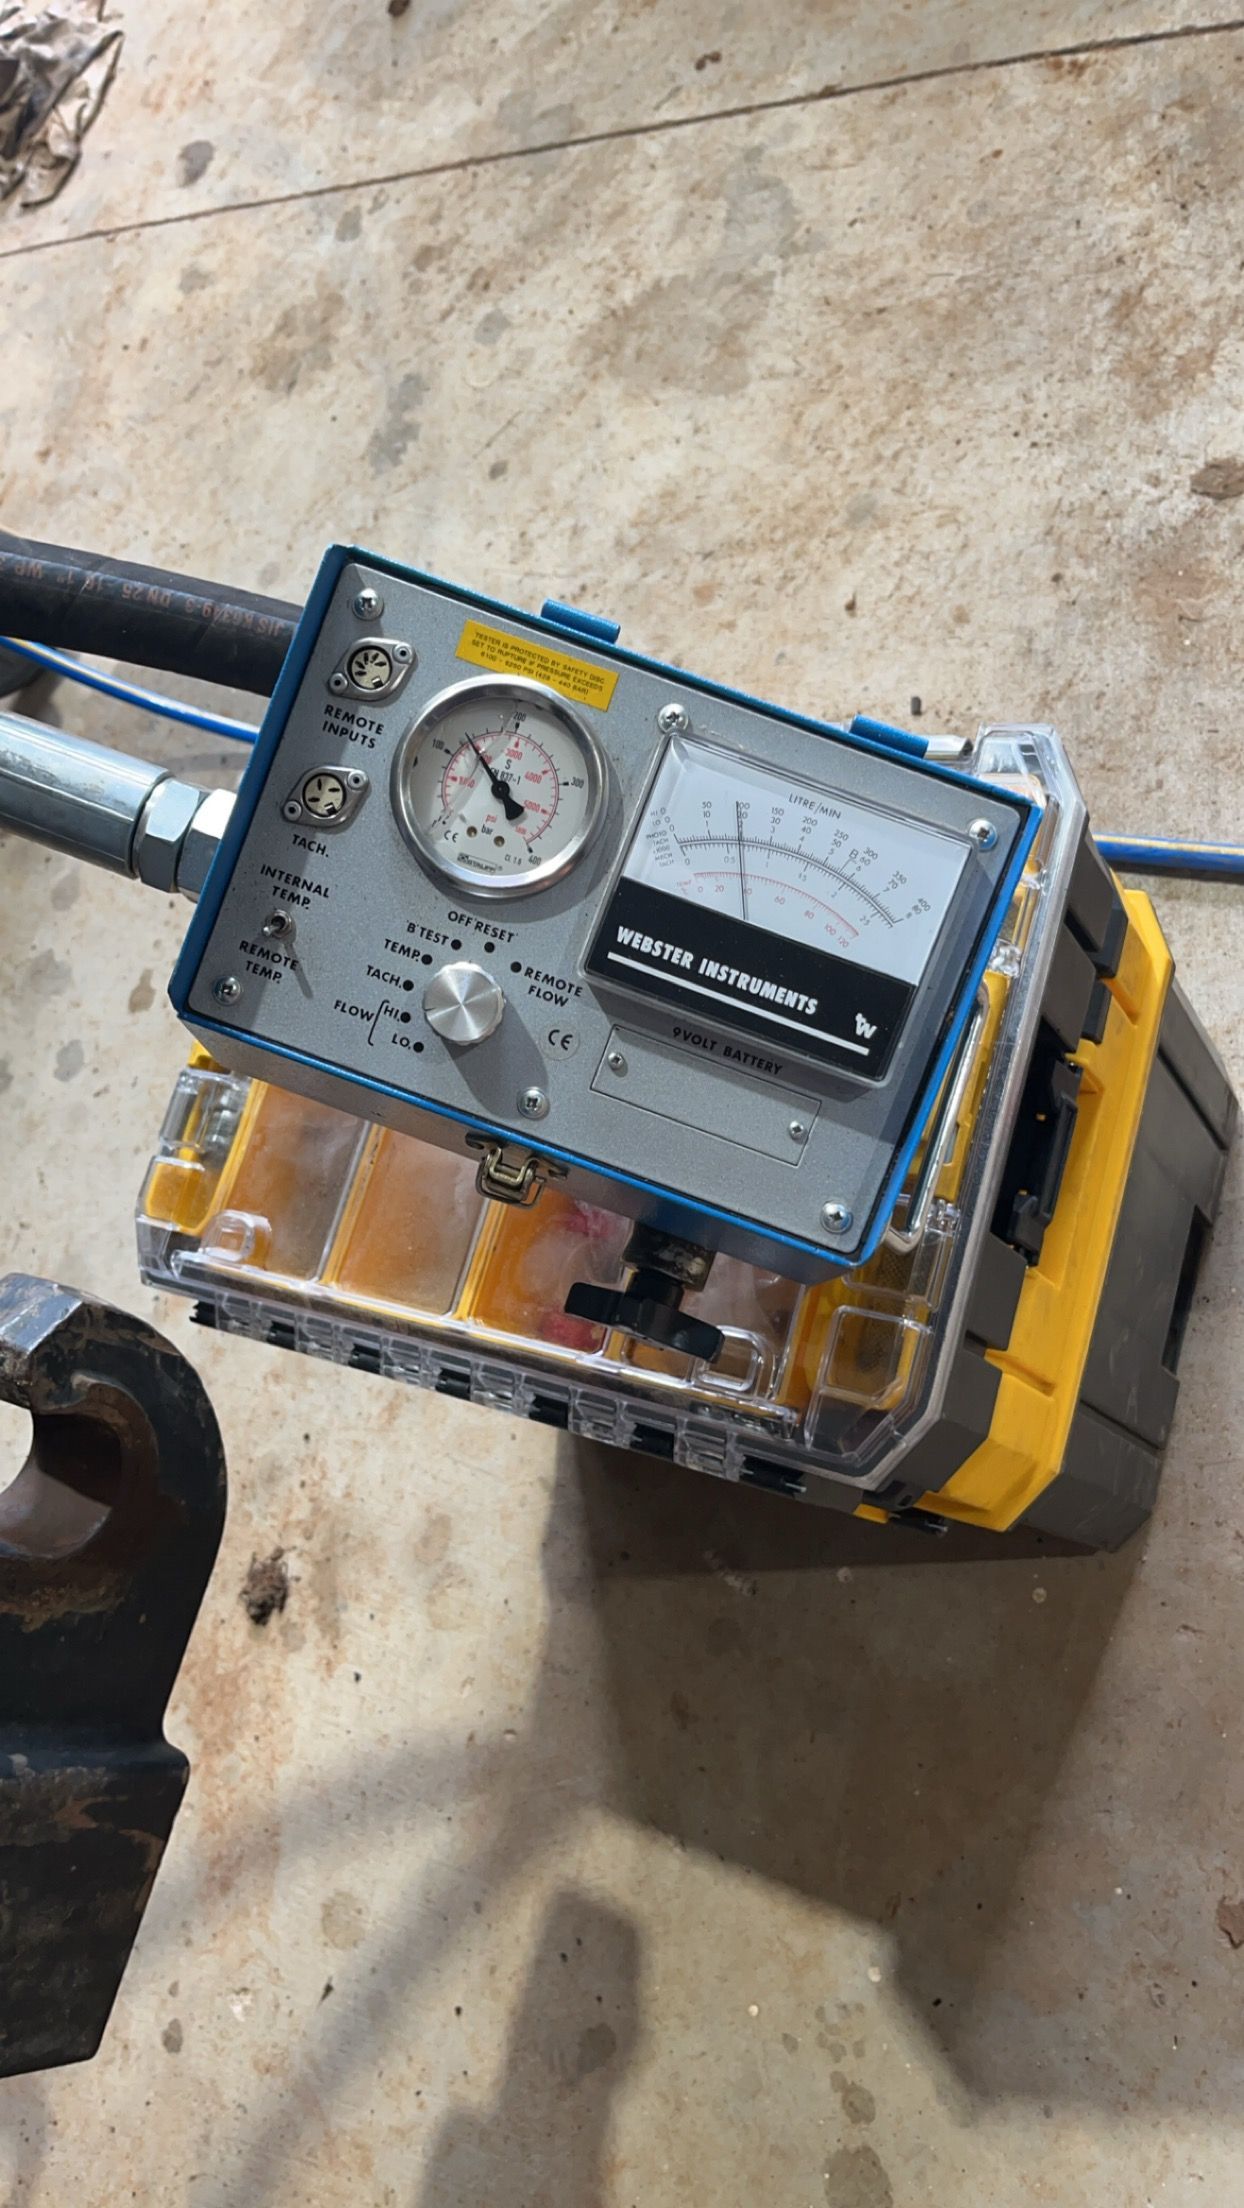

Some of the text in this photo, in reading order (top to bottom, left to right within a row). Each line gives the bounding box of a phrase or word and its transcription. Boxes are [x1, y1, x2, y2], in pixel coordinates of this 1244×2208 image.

[551, 657, 560, 667] BY
[563, 662, 588, 677] SAFETY
[324, 704, 384, 735] REMOTE
[513, 712, 526, 722] 200
[323, 721, 376, 749] INPUTS
[433, 739, 444, 750] 100
[505, 759, 512, 770] S
[571, 779, 584, 789] 300
[772, 807, 784, 816] 150
[788, 793, 841, 819] LITRE/MIN
[481, 824, 493, 835] bar
[669, 824, 674, 832] 0
[802, 816, 818, 827] 200
[292, 834, 329, 858] TACH.
[863, 847, 878, 860] 300
[528, 857, 541, 865] 400
[260, 864, 330, 898] INTERNAL
[272, 886, 311, 910] TEMP.
[448, 911, 472, 927] OFF
[420, 926, 449, 945] TEST
[239, 940, 299, 971] REMOTE
[384, 939, 421, 962] TEMP.
[245, 961, 282, 984] TEMP.
[366, 965, 402, 989] TACH.
[616, 926, 818, 1015] WEBSTER INSTRUMENTS
[524, 967, 583, 997] REMOTE
[528, 985, 569, 1007] FLOW
[334, 1000, 375, 1022] FLOW
[391, 1032, 411, 1049] LO.
[723, 1044, 783, 1076] BATTERY
